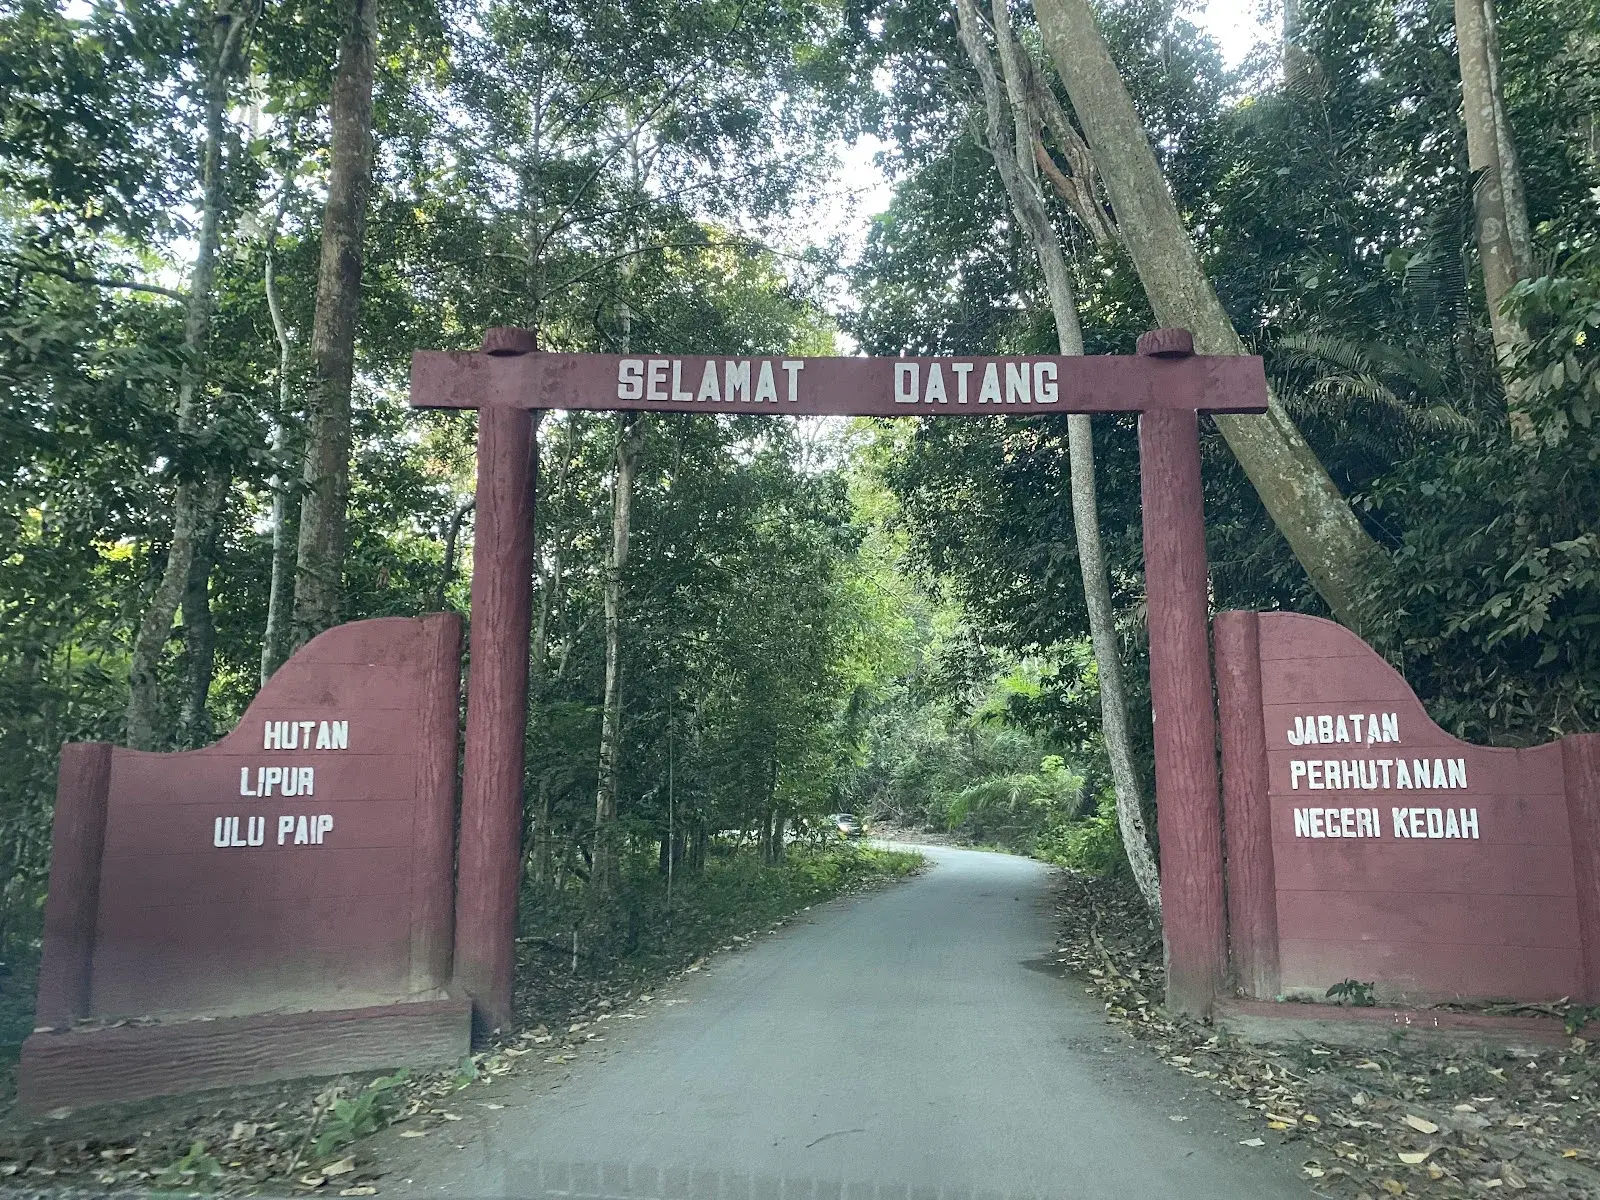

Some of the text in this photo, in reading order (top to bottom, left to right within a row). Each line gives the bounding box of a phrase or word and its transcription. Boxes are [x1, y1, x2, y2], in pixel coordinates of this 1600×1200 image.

[617, 358, 1060, 405] SELAMAT DATANG
[263, 720, 349, 750] HUTAN
[1287, 712, 1401, 746] JABATAN
[239, 766, 315, 798] LIPUR
[1290, 757, 1468, 790] PERHUTANAN
[213, 814, 334, 848] ULU PAIP
[1293, 807, 1480, 840] NEGERI KEDAH
